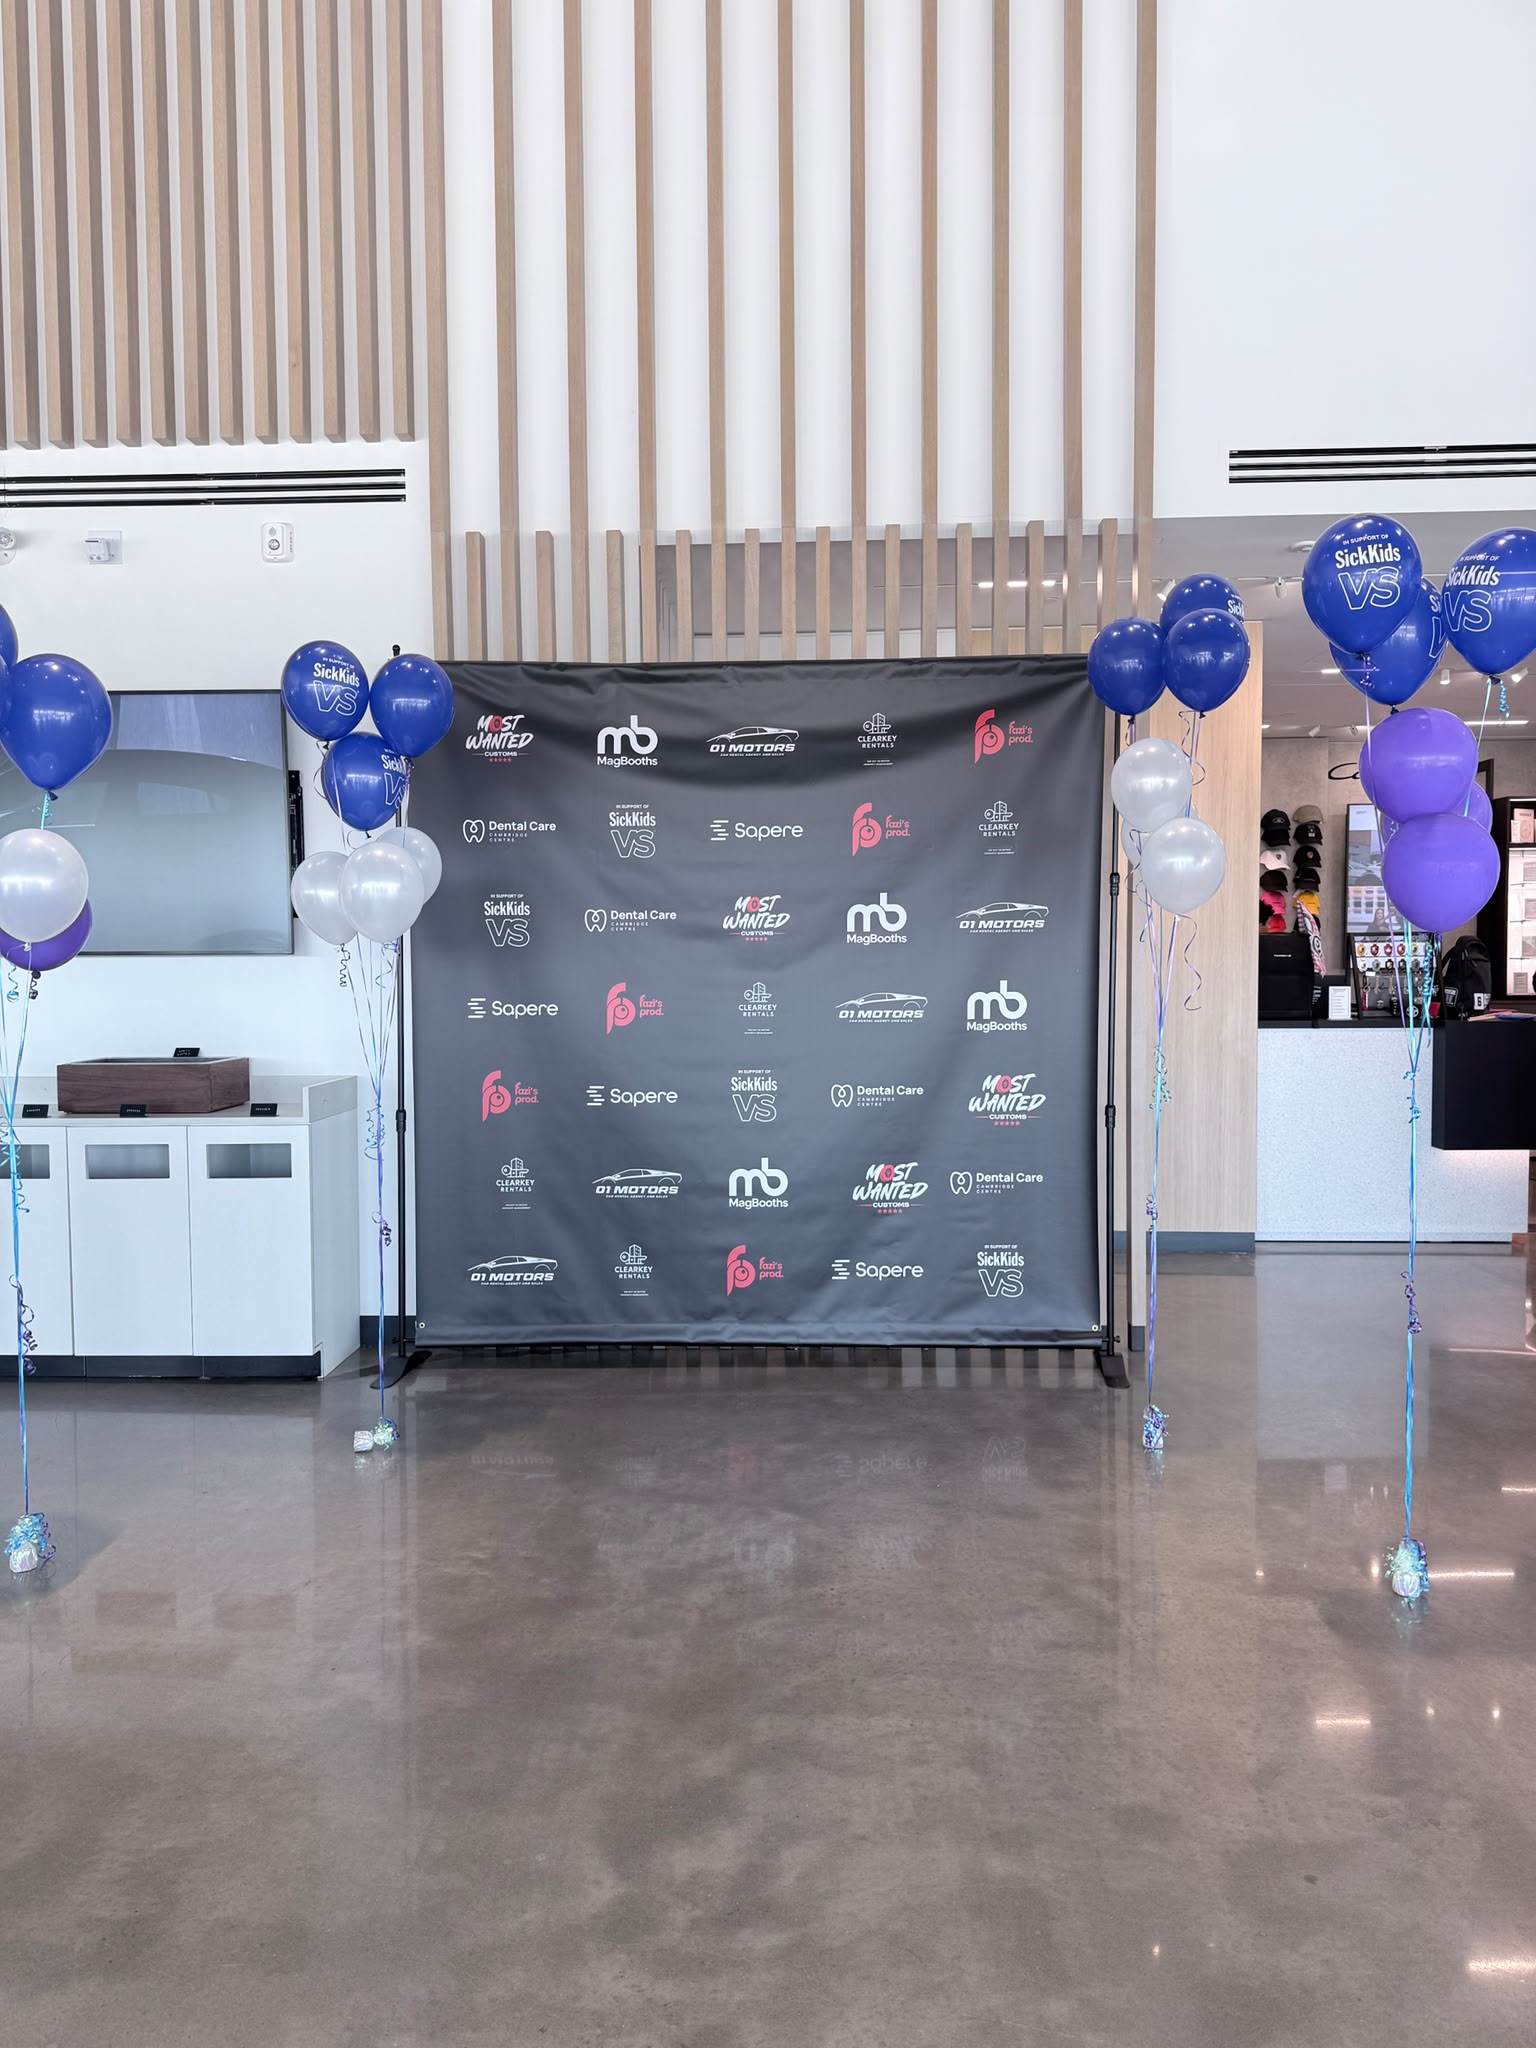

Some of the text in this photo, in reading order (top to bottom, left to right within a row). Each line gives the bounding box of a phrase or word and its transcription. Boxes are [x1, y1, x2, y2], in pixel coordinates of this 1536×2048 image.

[1350, 534, 1379, 543] SUPPORT
[1335, 543, 1401, 568] SickKids
[1446, 565, 1500, 587] SickKids
[1338, 566, 1400, 610] VS
[1444, 590, 1492, 632] VS
[313, 663, 360, 687] SickKids
[313, 680, 358, 716] VS
[477, 715, 526, 733] MOST
[1009, 721, 1033, 734] fazi's
[466, 732, 534, 751] WANTED
[858, 735, 898, 743] CLEARKEY
[1009, 735, 1033, 745] prod.
[710, 744, 795, 752] 01 MOTORS
[597, 756, 658, 768] MagBooths
[489, 821, 557, 831] Dental Care
[609, 812, 656, 827] SickKids
[886, 815, 909, 828] fazi's
[735, 823, 804, 842] Sapere
[886, 828, 910, 839] prod.
[979, 823, 1019, 831] CLEARKEY
[611, 829, 656, 858] VS
[484, 901, 530, 916] SickKids
[735, 895, 782, 912] MOST
[611, 910, 677, 920] Dental Care
[723, 911, 791, 931] WANTED
[959, 920, 1045, 929] 01 MOTORS
[486, 919, 530, 947] VS
[847, 934, 907, 945] MagBooths
[640, 995, 663, 1008] fazi's
[492, 1001, 559, 1020] Sapere
[640, 1008, 664, 1018] prod.
[839, 1010, 924, 1018] 01 MOTORS
[967, 1022, 1027, 1033] MagBooths
[515, 1083, 538, 1096] fazi's
[731, 1077, 778, 1092] SickKids
[982, 1074, 1036, 1094] MOST
[857, 1086, 924, 1096] Dental Care
[515, 1095, 539, 1106] prod.
[610, 1088, 678, 1108] Sapere
[969, 1093, 1047, 1113] WANTED
[733, 1094, 777, 1122] VS
[866, 1162, 918, 1183] MOST
[977, 1173, 1043, 1183] Dental Care
[596, 1186, 679, 1194] 01 MOTORS
[853, 1182, 929, 1201] WANTED
[729, 1199, 788, 1210] MagBooths
[760, 1257, 783, 1270] fazi's
[977, 1252, 1025, 1267] SickKids
[615, 1266, 653, 1274] CLEARKEY
[760, 1270, 784, 1280] prod.
[856, 1262, 924, 1281] Sapere
[471, 1273, 554, 1281] 01 MOTORS
[979, 1269, 1024, 1298] VS
